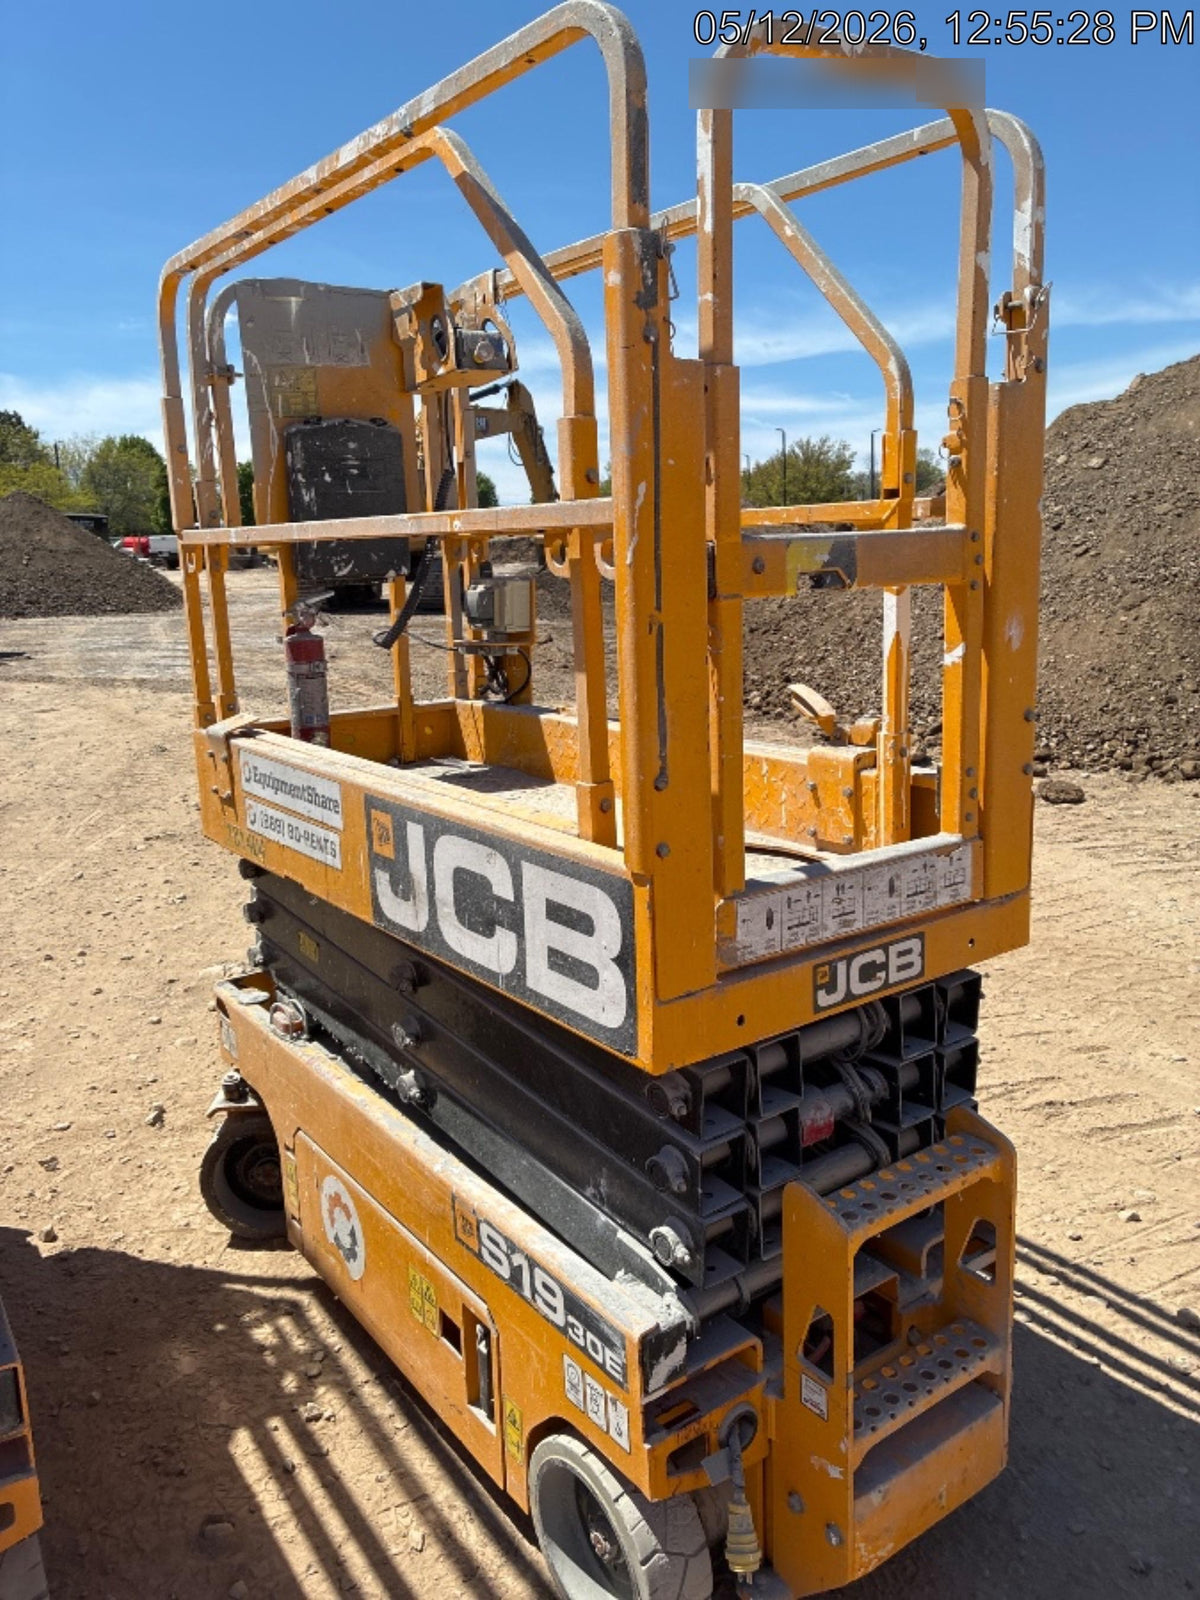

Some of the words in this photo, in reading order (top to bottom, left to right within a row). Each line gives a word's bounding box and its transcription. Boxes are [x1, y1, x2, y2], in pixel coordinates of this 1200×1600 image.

[253, 765, 340, 815] EquipmentShare
[375, 821, 627, 1028] JCB
[816, 937, 923, 1009] JCB
